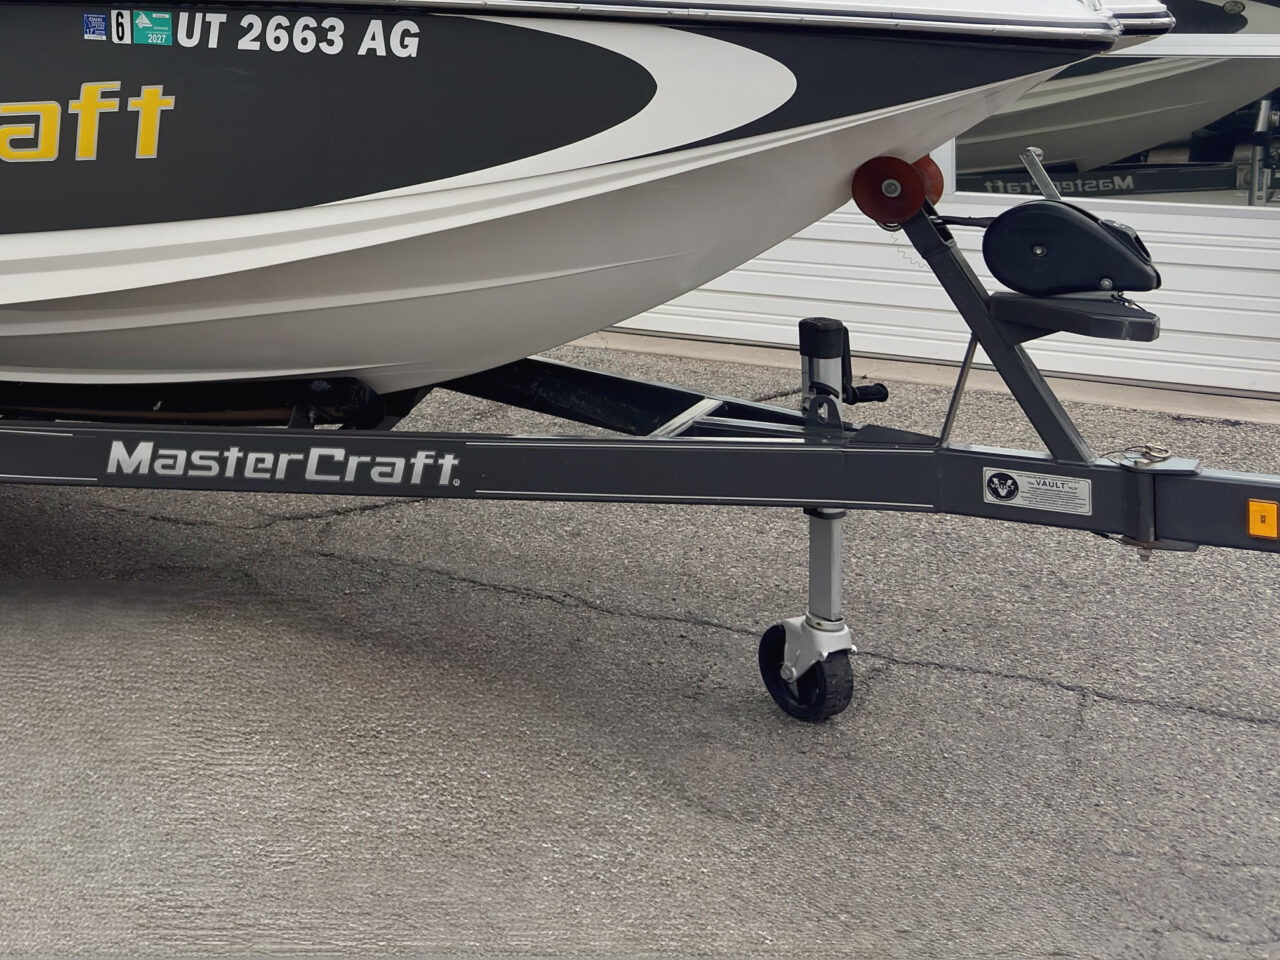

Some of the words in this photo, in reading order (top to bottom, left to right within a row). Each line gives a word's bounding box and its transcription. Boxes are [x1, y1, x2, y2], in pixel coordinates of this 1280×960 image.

[116, 11, 125, 42] 6
[177, 11, 227, 49] UT
[237, 13, 345, 55] 2663
[357, 19, 420, 58] AG
[147, 33, 166, 44] 2027
[1035, 479, 1066, 489] VAULT
